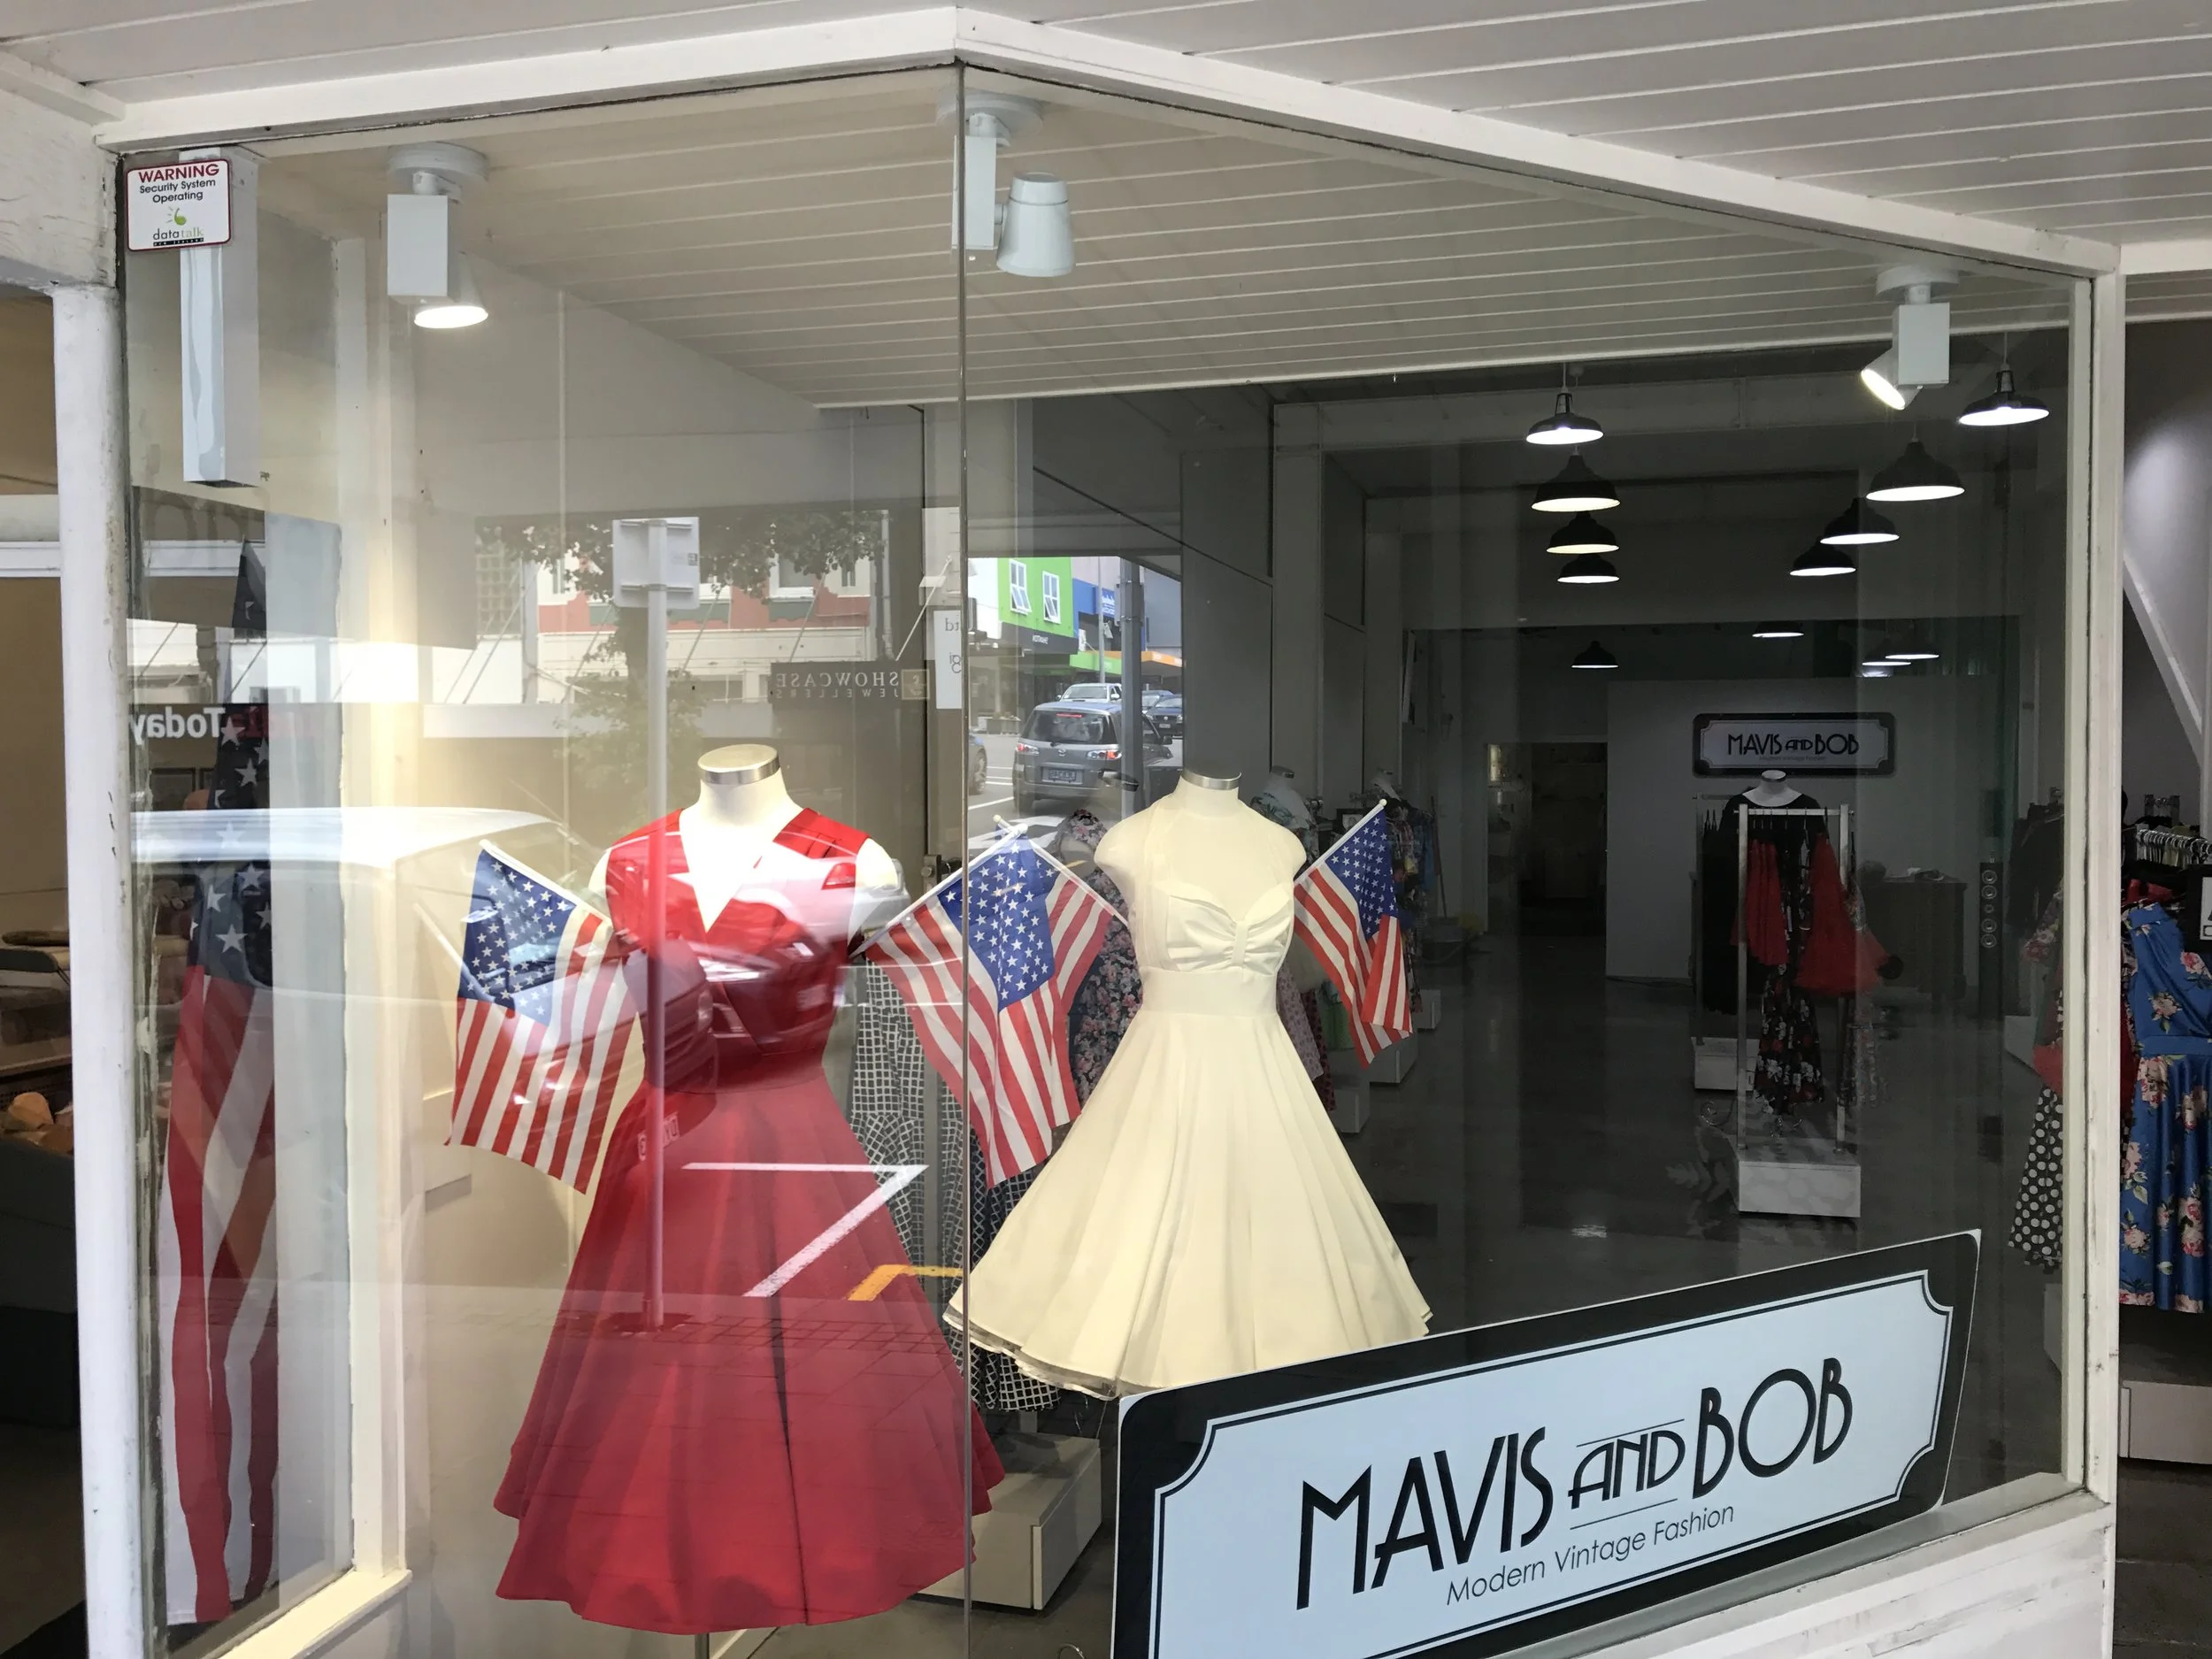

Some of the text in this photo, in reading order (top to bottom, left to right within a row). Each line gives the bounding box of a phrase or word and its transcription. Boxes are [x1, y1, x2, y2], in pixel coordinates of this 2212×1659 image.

[138, 163, 219, 183] WARNING
[140, 179, 216, 194] Security System
[152, 191, 204, 204] Operating
[1728, 733, 1859, 755] MAVIS AND BOB
[1296, 1357, 1853, 1610] MAVIS AND BOB
[1447, 1506, 1734, 1606] Modern Vintage Fashion
